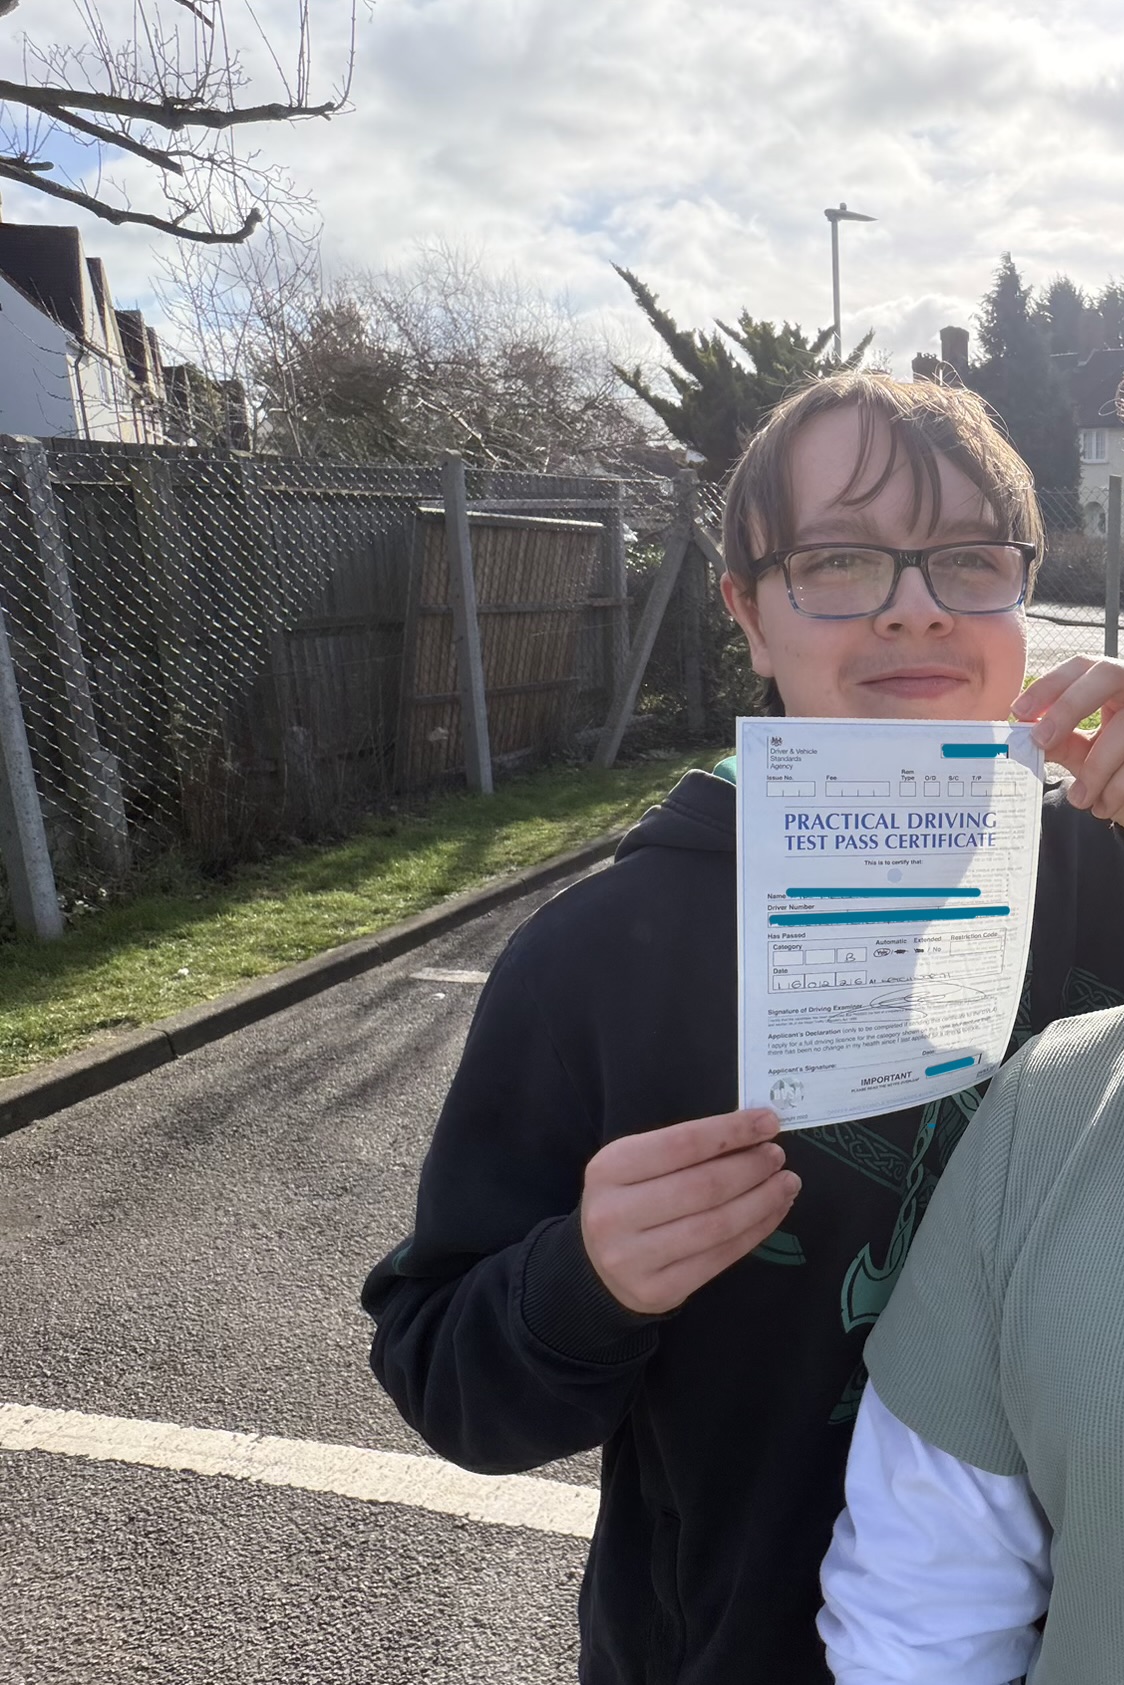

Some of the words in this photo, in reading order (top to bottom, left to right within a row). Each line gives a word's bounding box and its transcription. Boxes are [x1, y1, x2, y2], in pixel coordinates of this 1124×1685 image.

[784, 813, 900, 830] PRACTICAL
[907, 812, 997, 830] DRIVING
[785, 834, 828, 851] TEST
[834, 834, 879, 850] PASS
[884, 832, 996, 850] CERTIFICATE
[950, 933, 981, 941] Restriction
[845, 952, 856, 963] B
[768, 1008, 799, 1016] Signature
[768, 1031, 804, 1040] Applicant's
[805, 1028, 841, 1037] Declaration
[874, 1022, 903, 1030] completed
[814, 1038, 834, 1046] driving
[823, 1044, 844, 1052] change
[768, 1066, 803, 1075] Applicant's
[860, 1070, 913, 1086] IMPORTANT
